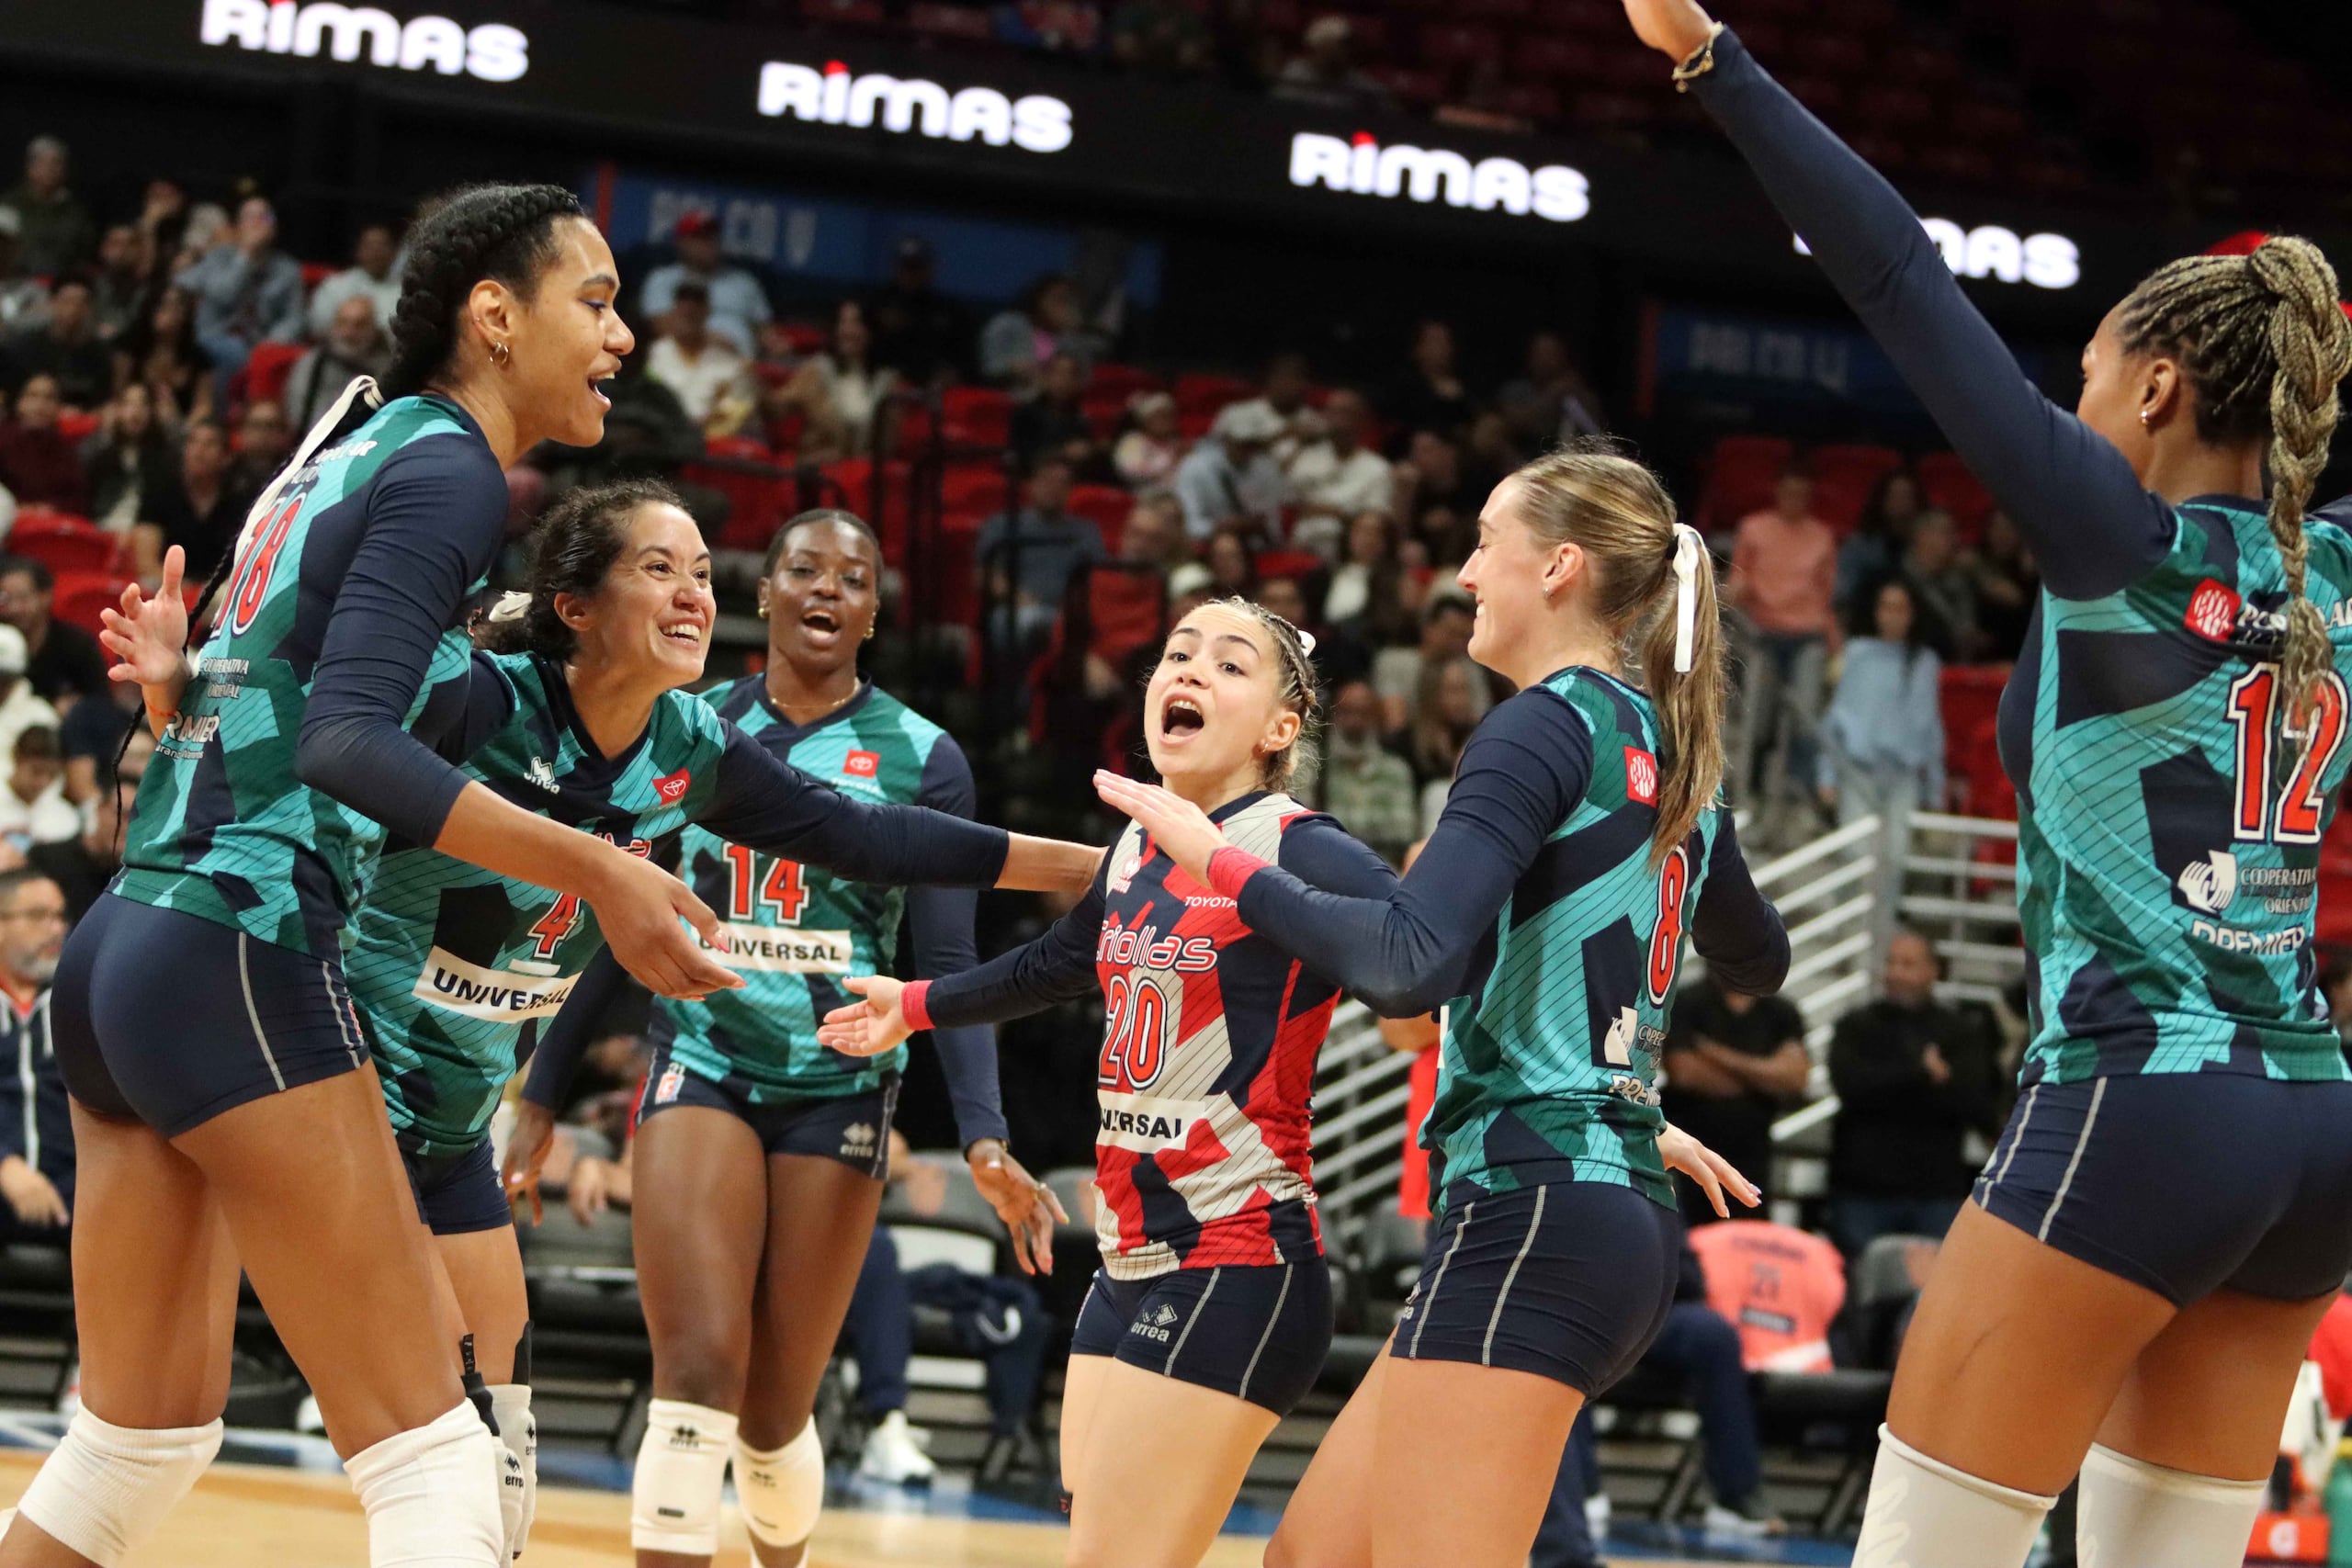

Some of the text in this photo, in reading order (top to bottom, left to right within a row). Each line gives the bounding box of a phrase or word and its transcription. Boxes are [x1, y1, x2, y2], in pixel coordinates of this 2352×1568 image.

[2226, 660, 2350, 845] 12
[723, 840, 809, 926] 14
[1184, 896, 1238, 908] TOYOTA
[526, 891, 582, 961] 4
[1646, 843, 1690, 1009] 8
[433, 967, 570, 1011] UNIVERSAL
[1098, 976, 1168, 1091] 20
[1130, 1321, 1170, 1343] errea
